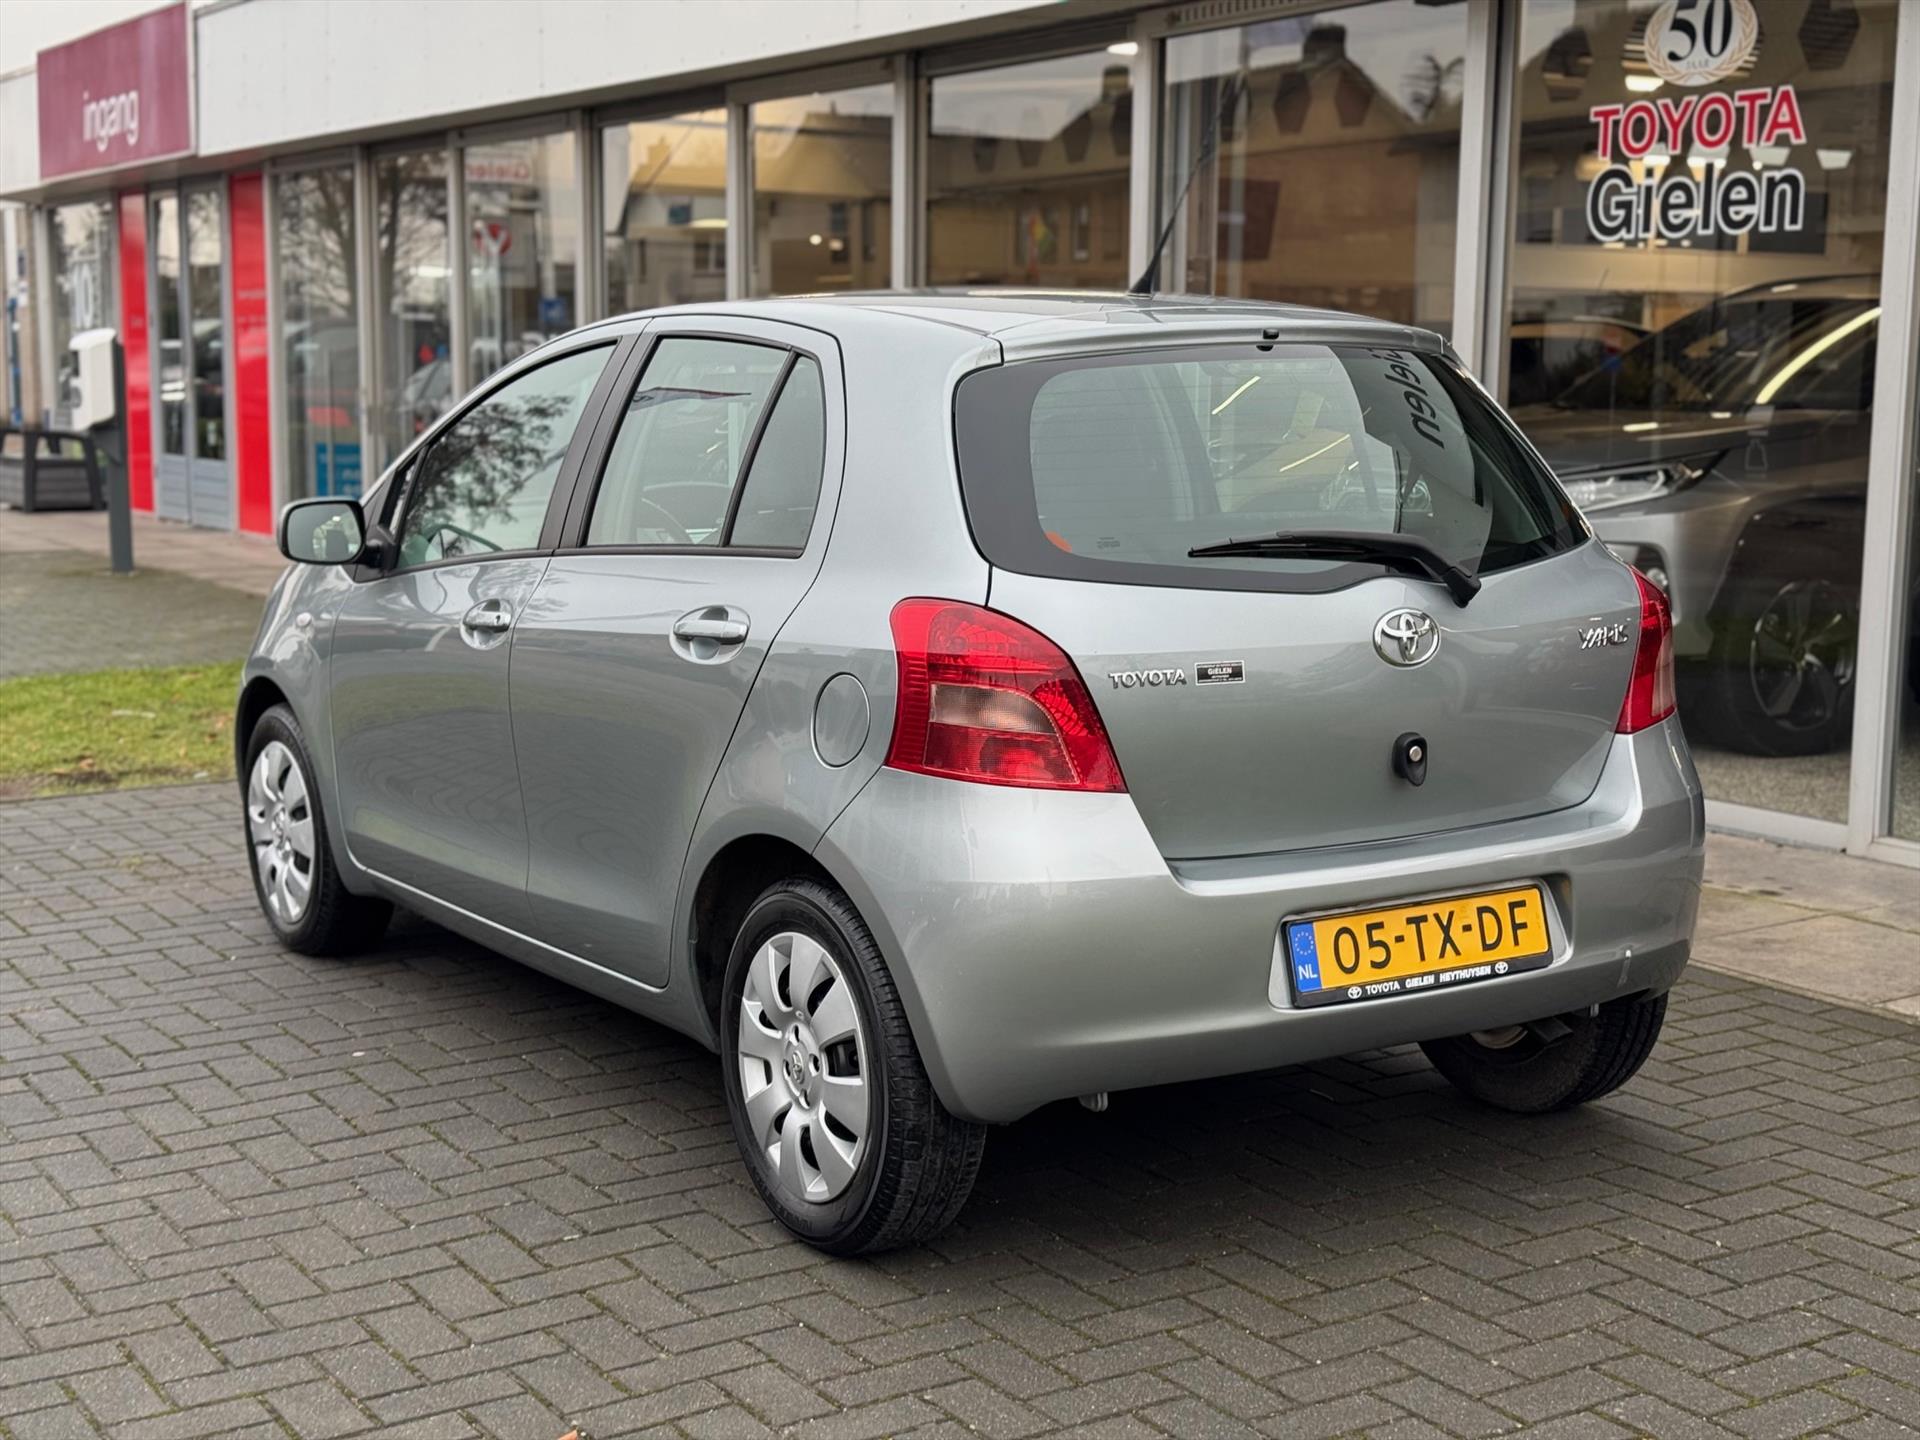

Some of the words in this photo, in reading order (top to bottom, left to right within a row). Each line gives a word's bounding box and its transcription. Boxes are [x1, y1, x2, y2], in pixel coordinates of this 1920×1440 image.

[1667, 0, 1733, 62] 50
[83, 90, 139, 153] ingang
[1590, 85, 1807, 160] TOYOTA
[1586, 163, 1806, 242] Gielen
[1108, 668, 1187, 690] TOYOTA
[1333, 899, 1529, 975] 05-TX-DF
[1298, 964, 1318, 981] NL
[1365, 981, 1401, 996] TOYOTA
[1405, 974, 1435, 988] GIELEN
